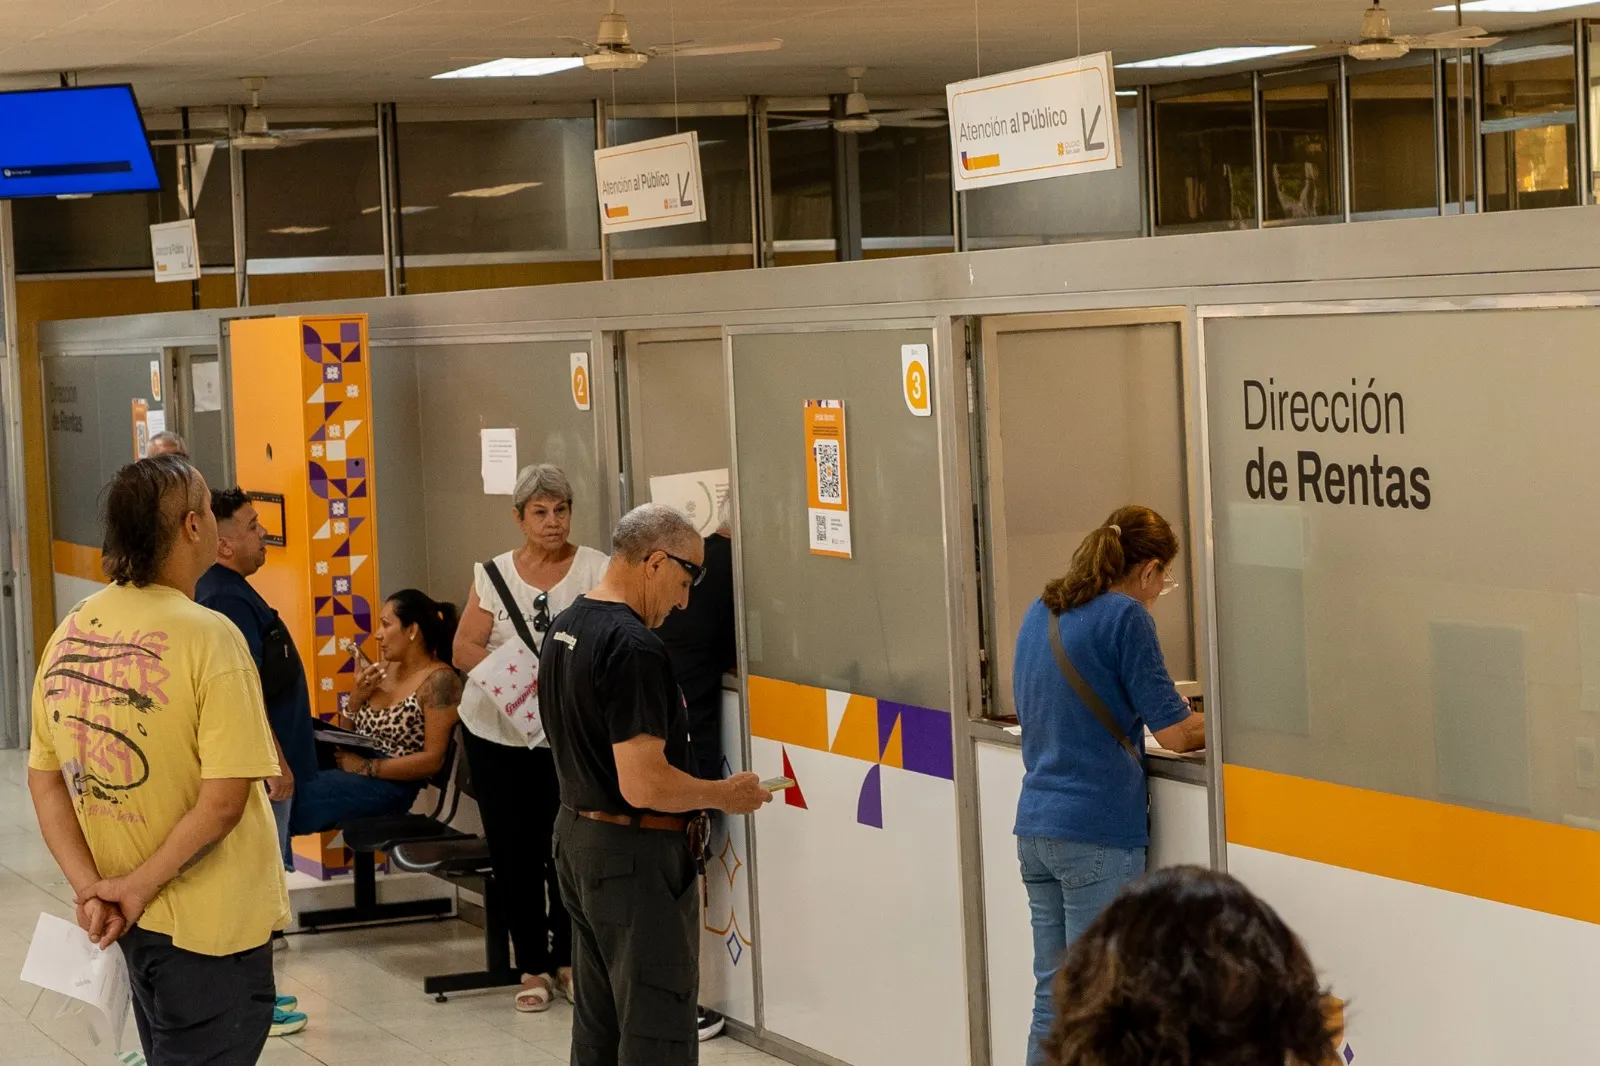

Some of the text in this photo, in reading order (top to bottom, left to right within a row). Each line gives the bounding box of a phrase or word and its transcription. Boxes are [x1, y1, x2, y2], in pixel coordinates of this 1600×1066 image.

[960, 107, 1068, 142] Atención al Público
[602, 171, 670, 196] Atención al Público
[577, 374, 584, 396] 2
[912, 371, 922, 400] 3
[1243, 377, 1405, 434] Dirección
[1245, 447, 1431, 510] de Rentas
